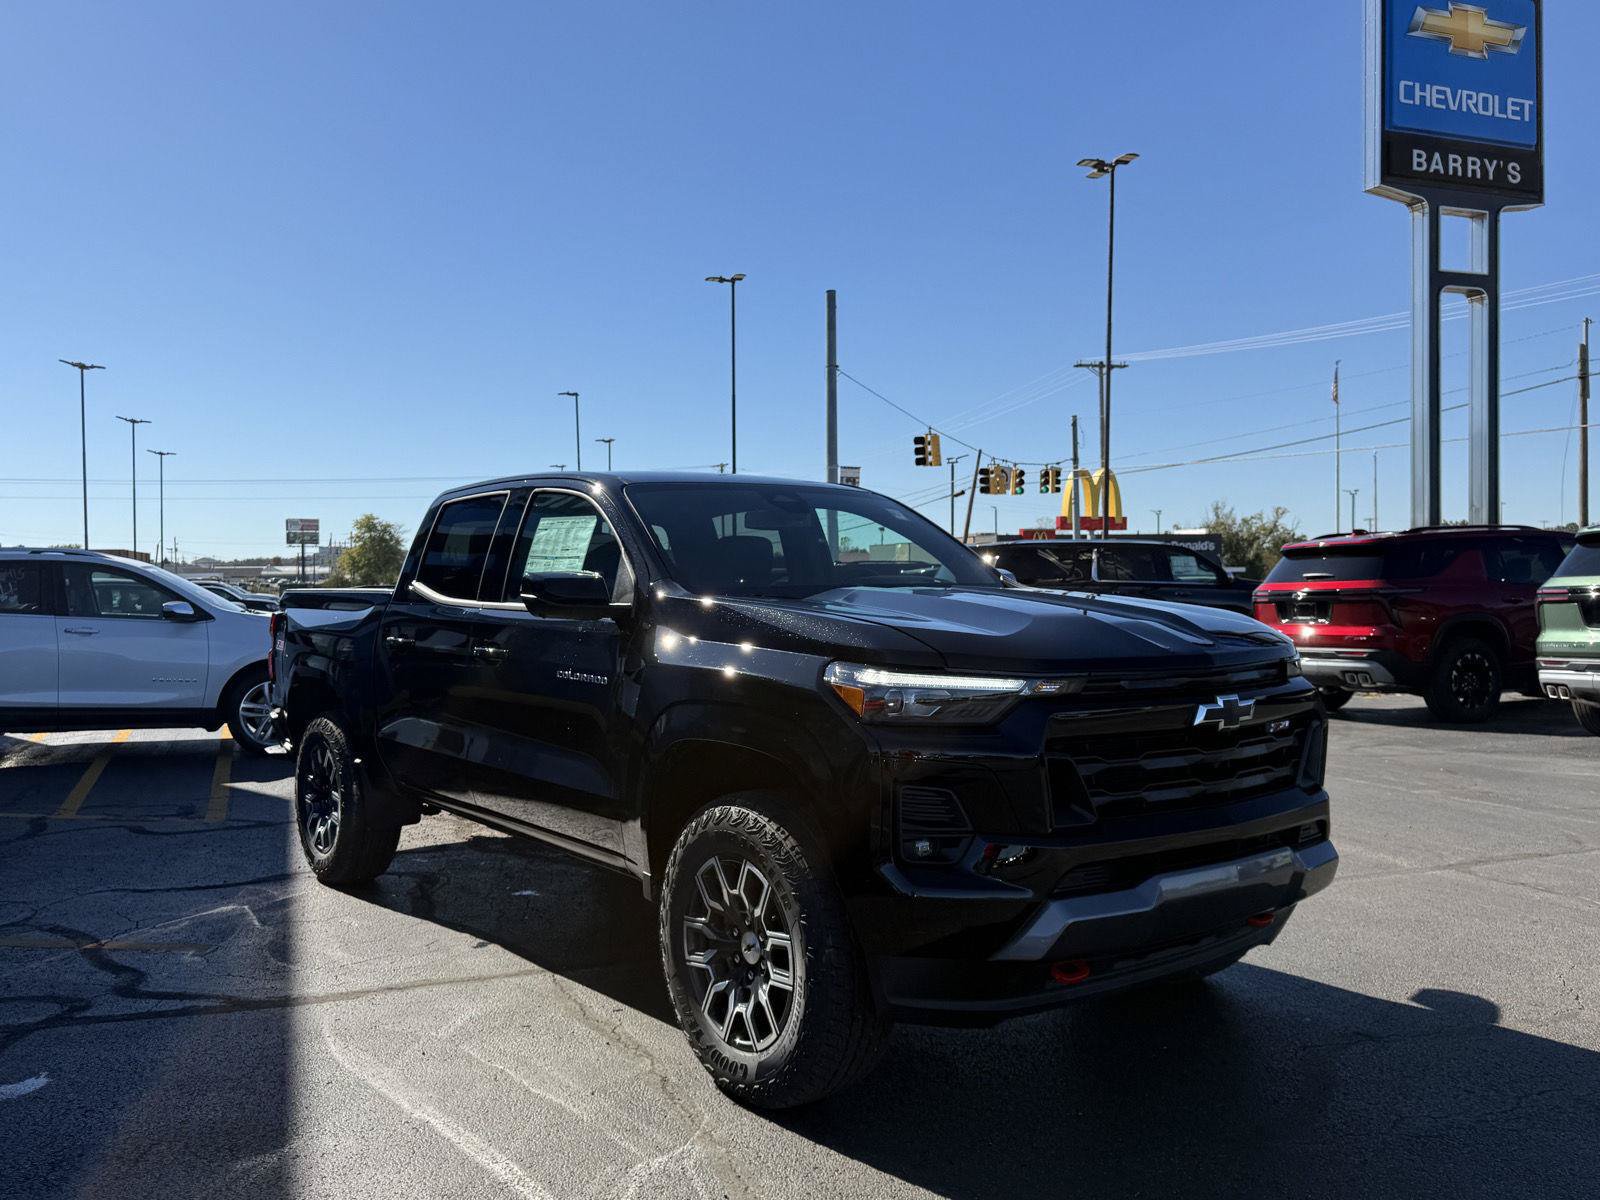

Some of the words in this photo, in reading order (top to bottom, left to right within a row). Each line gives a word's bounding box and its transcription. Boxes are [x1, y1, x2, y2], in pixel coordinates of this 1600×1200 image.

[1399, 80, 1533, 122] CHEVROLET
[1412, 149, 1521, 184] BARRY'S
[1168, 541, 1216, 551] Donald's
